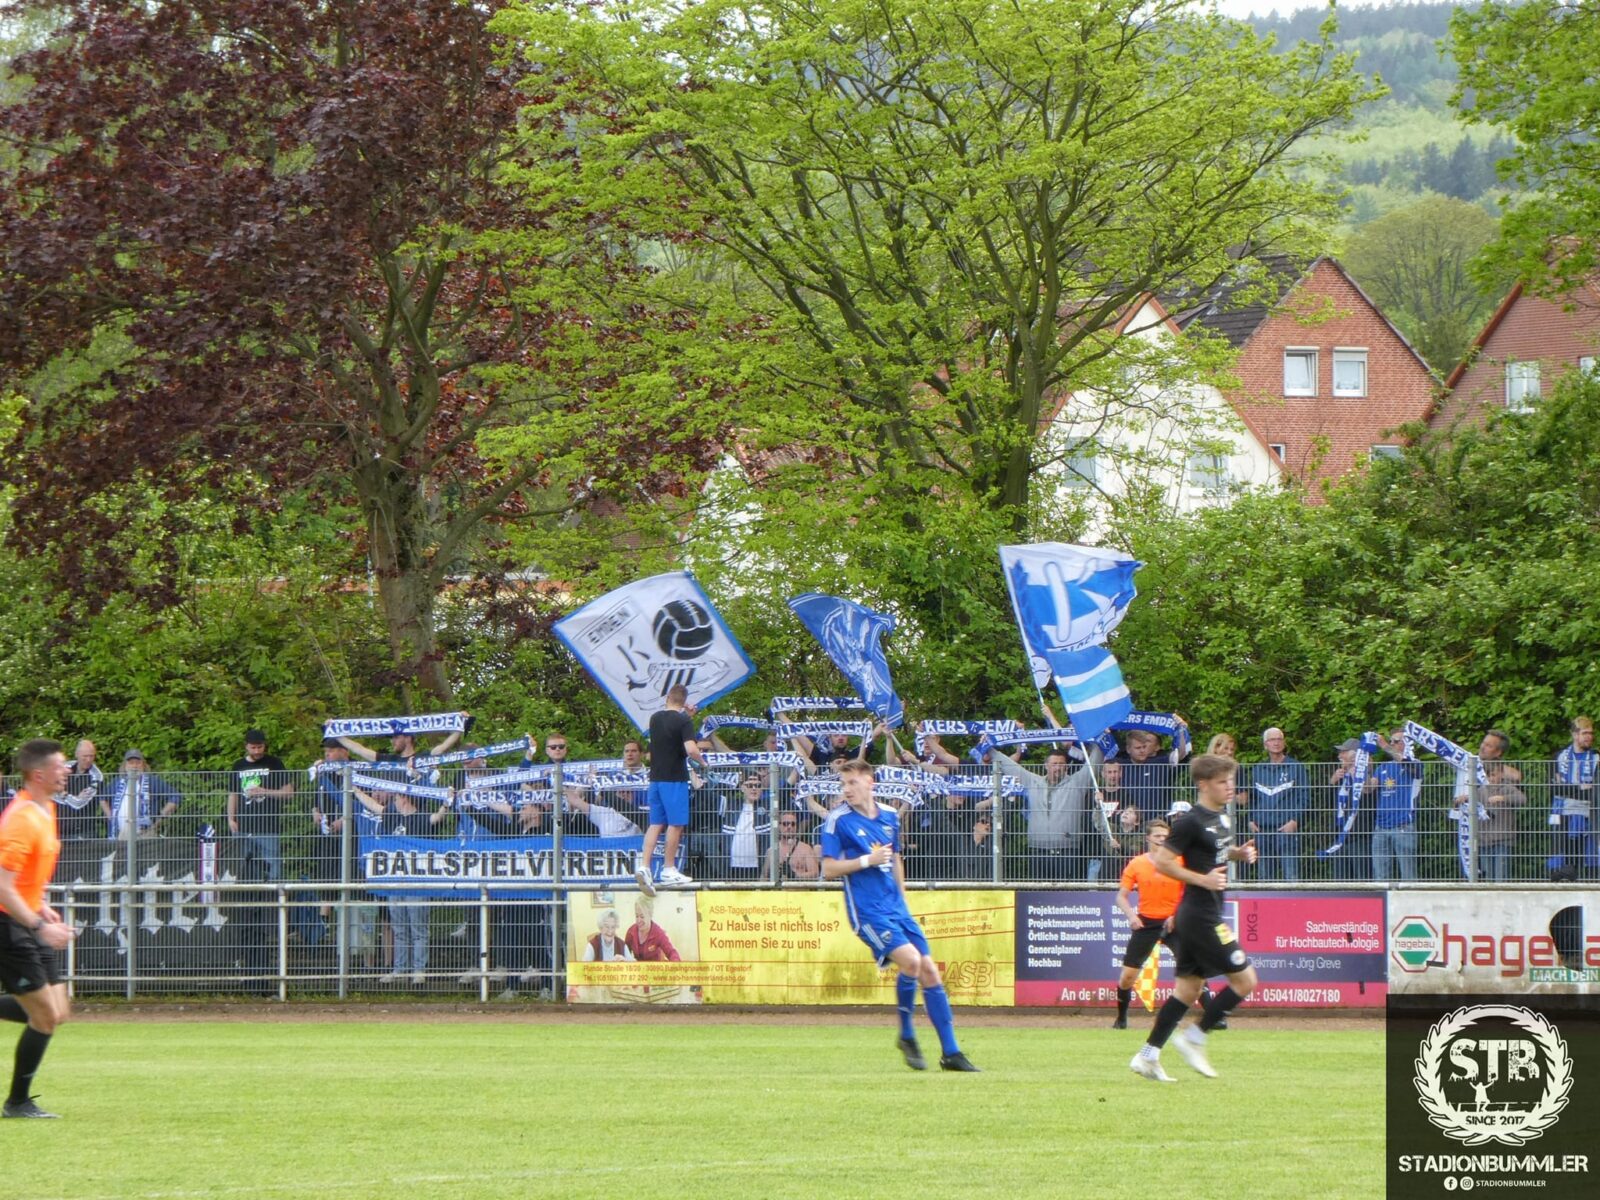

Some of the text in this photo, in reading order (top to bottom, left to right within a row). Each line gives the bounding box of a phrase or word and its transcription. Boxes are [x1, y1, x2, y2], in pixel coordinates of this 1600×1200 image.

[324, 713, 465, 736] KICKERS EMDEN
[924, 720, 966, 733] KERS
[461, 790, 507, 804] CKERS
[1028, 905, 1101, 917] Projektentwicklung
[710, 920, 840, 932] Zu Hause ist nichts los?
[1028, 918, 1104, 930] Projektmanagement
[1246, 913, 1258, 942] DKG
[1306, 920, 1379, 936] Sachverständige
[1028, 930, 1106, 941] Örtliche Bauaufsicht
[710, 937, 820, 950] Kommen Sie zu uns!
[1275, 936, 1380, 951] für Hochbautechnologie
[1394, 939, 1436, 954] hagebau
[1028, 945, 1082, 956] Generalplaner
[1442, 923, 1600, 978] hagea
[1028, 958, 1062, 968] Hochbau
[1296, 956, 1315, 971] Jörg
[1316, 956, 1342, 969] Greve
[943, 961, 993, 989] ASB
[1532, 969, 1568, 982] MACH
[1061, 988, 1076, 1001] An
[1262, 989, 1341, 1003] 05041/8027180
